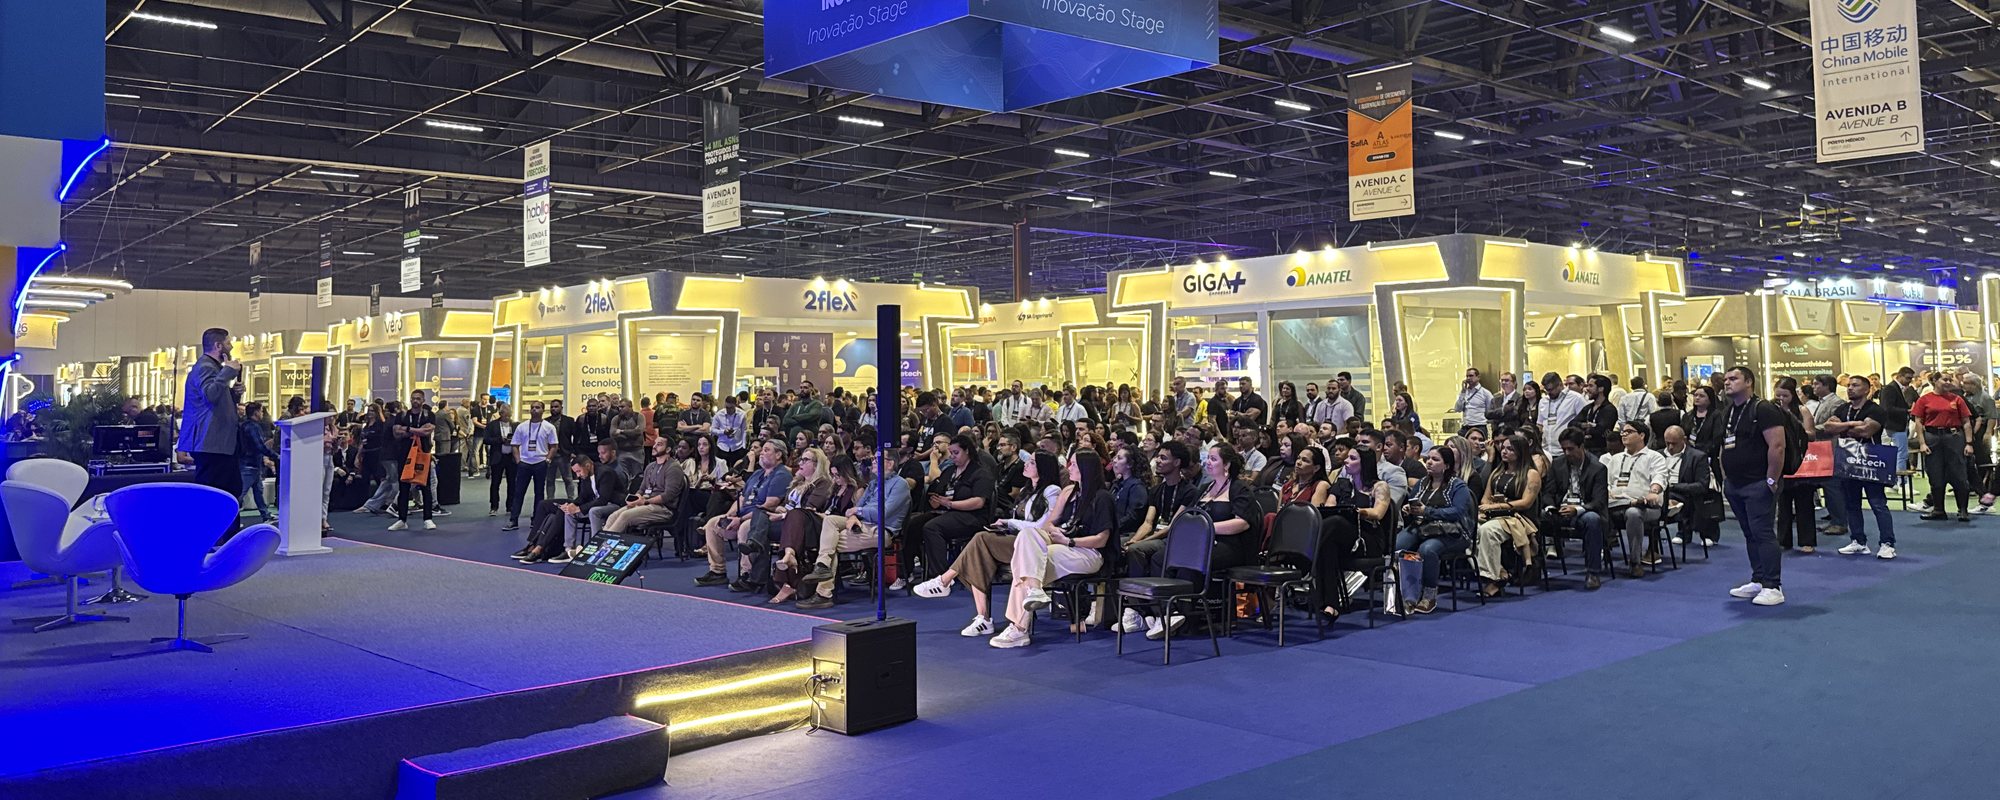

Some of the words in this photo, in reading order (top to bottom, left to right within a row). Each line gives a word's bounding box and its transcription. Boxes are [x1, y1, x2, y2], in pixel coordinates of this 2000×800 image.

[807, 14, 864, 45] Inovação
[867, 0, 908, 26] Stage
[1120, 8, 1165, 34] Stage
[1821, 24, 1907, 54] 中国移动
[1822, 54, 1860, 69] China
[1863, 46, 1908, 62] Mobile
[1822, 66, 1910, 87] International
[1825, 102, 1892, 120] AVENIDA
[1898, 100, 1907, 110] B
[1838, 116, 1886, 130] AVENUE
[1890, 115, 1898, 124] B
[704, 146, 731, 159] PROTEGIDOS
[705, 157, 717, 165] TODO
[723, 151, 739, 160] BRASIL
[1355, 176, 1397, 188] AVENIDA
[1400, 174, 1406, 182] C
[707, 188, 731, 200] AVENIDA
[732, 186, 736, 195] D
[1363, 186, 1392, 196] AVENUE
[527, 232, 544, 240] AVENIDA
[1306, 270, 1352, 286] ANATEL
[1574, 270, 1600, 285] ANATEL
[1816, 286, 1856, 297] BRASIL
[582, 345, 587, 353] 2
[1790, 360, 1833, 368] Conectividade
